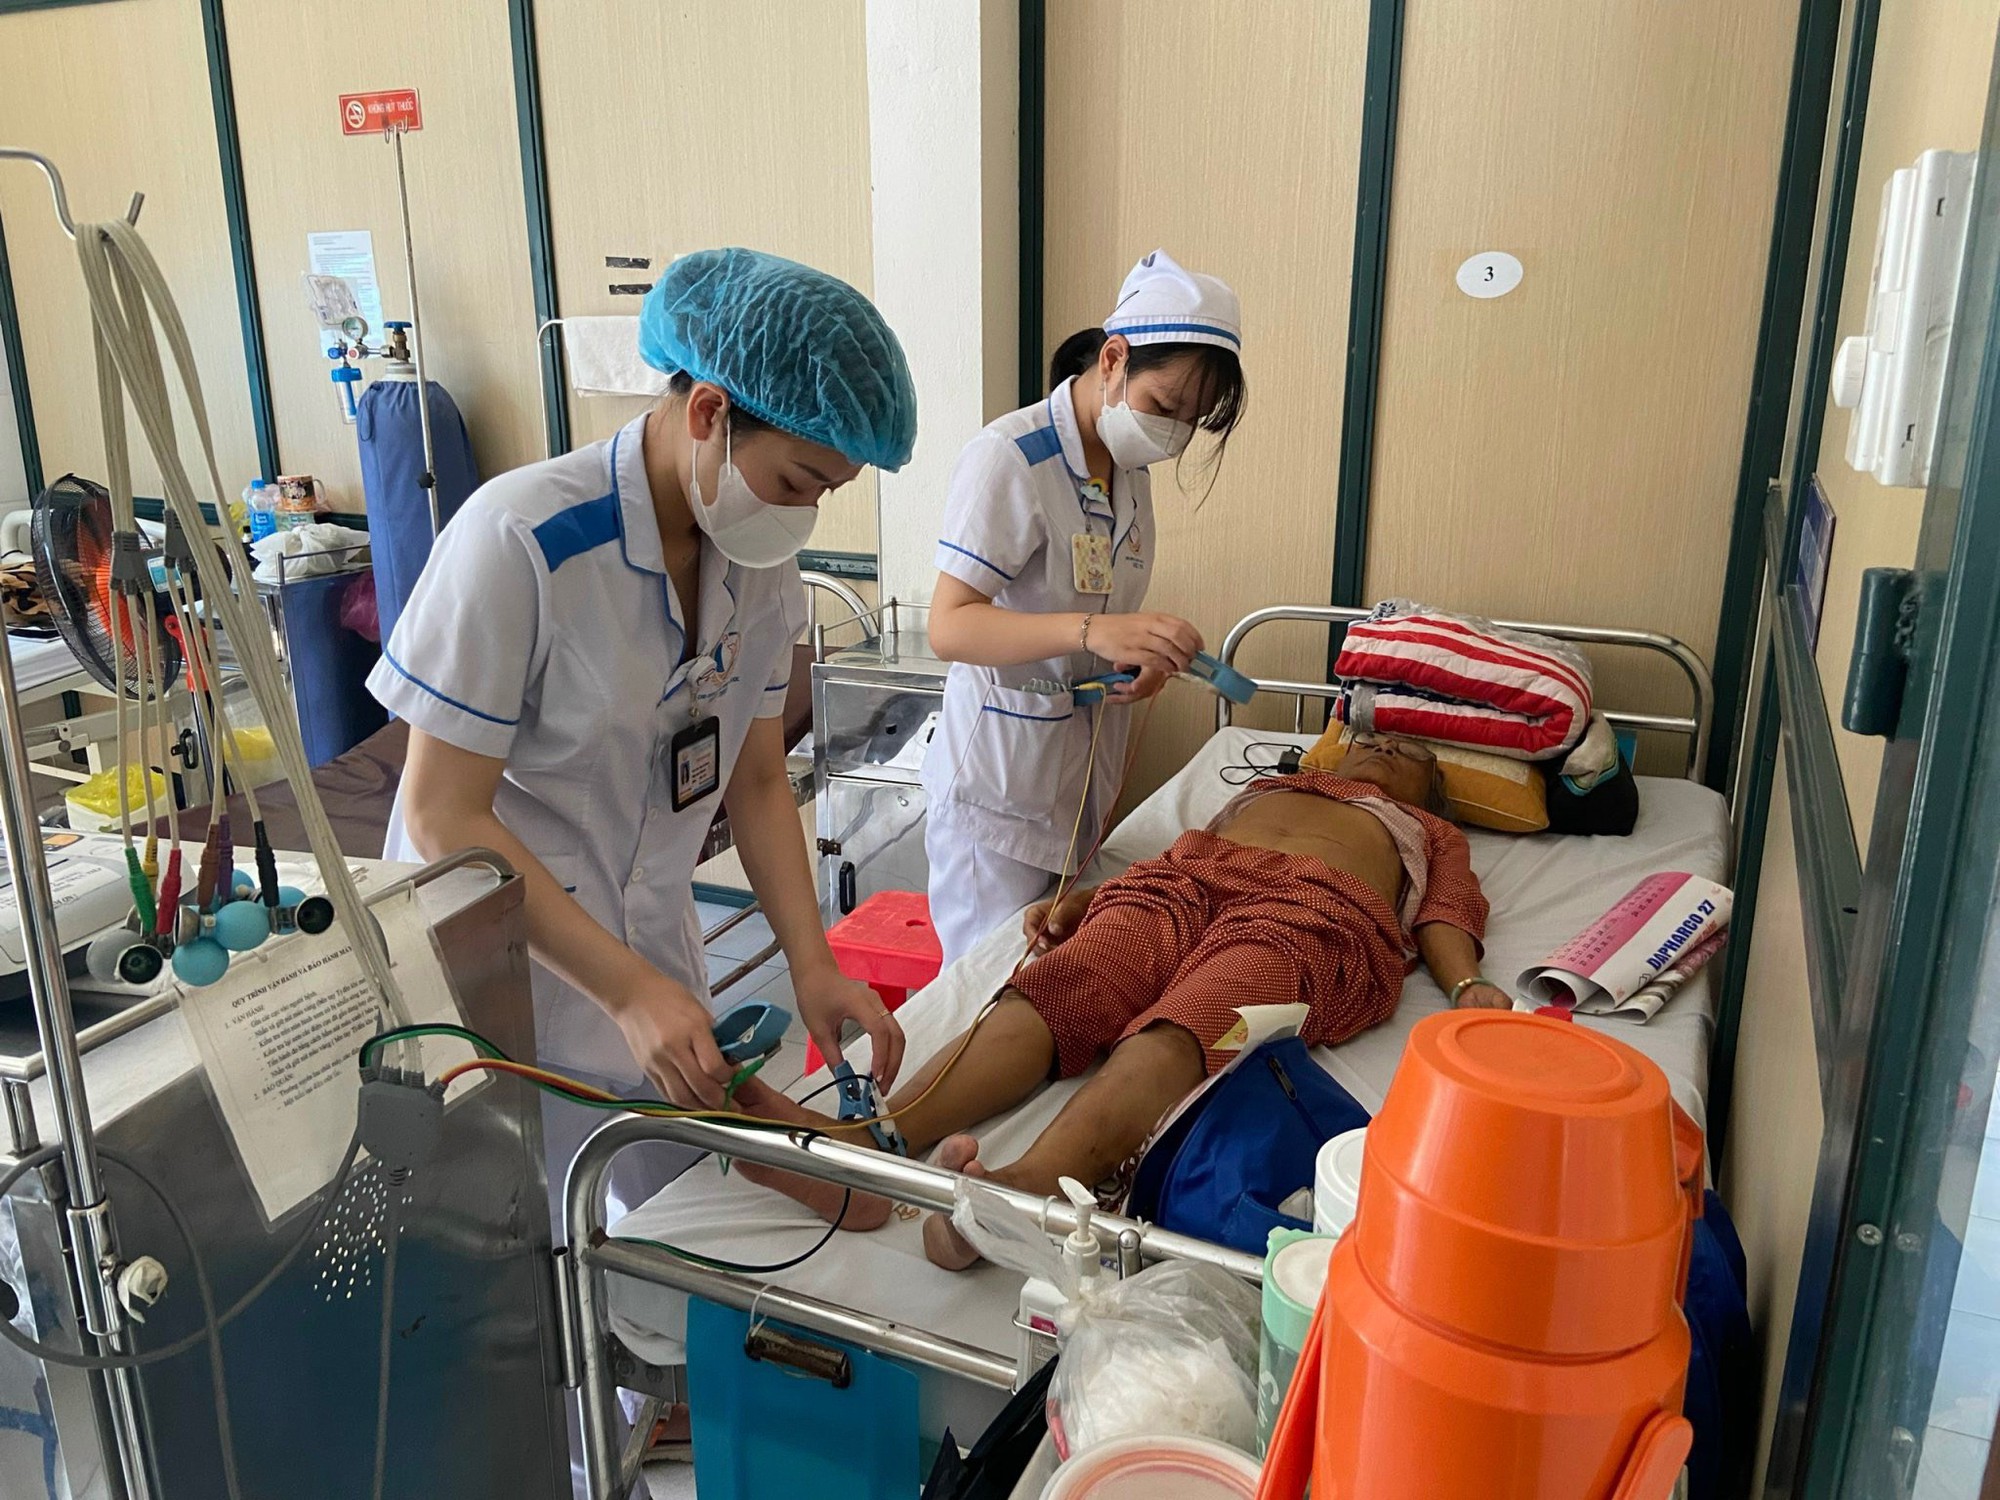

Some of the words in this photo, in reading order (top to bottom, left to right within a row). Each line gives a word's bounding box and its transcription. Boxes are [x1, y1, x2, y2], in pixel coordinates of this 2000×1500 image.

[396, 96, 414, 111] THUỐC
[1484, 266, 1494, 281] 3
[1646, 913, 1704, 971] DAPHARCO
[1698, 899, 1716, 916] 27
